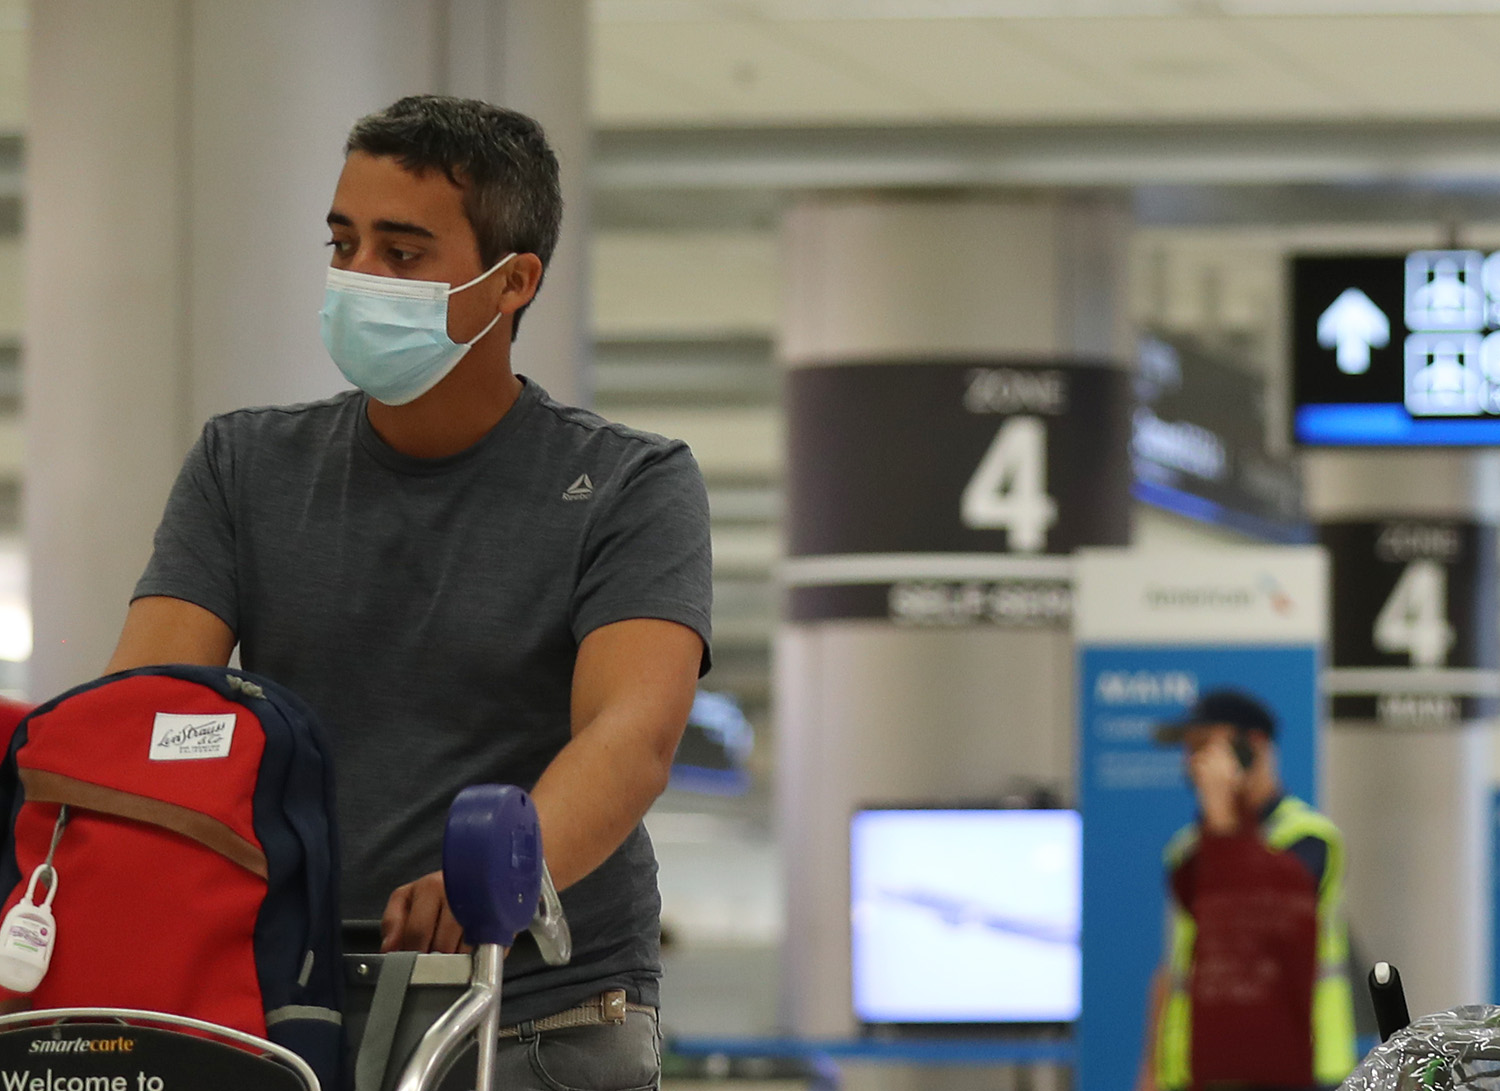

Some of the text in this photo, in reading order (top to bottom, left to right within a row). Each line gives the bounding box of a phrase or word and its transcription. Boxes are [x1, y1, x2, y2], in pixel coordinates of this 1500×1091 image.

[965, 368, 1068, 415] ZONE
[961, 416, 1059, 551] 4
[1372, 559, 1459, 668] 4
[1094, 669, 1199, 705] MAIN
[29, 1036, 134, 1053] smartecarte
